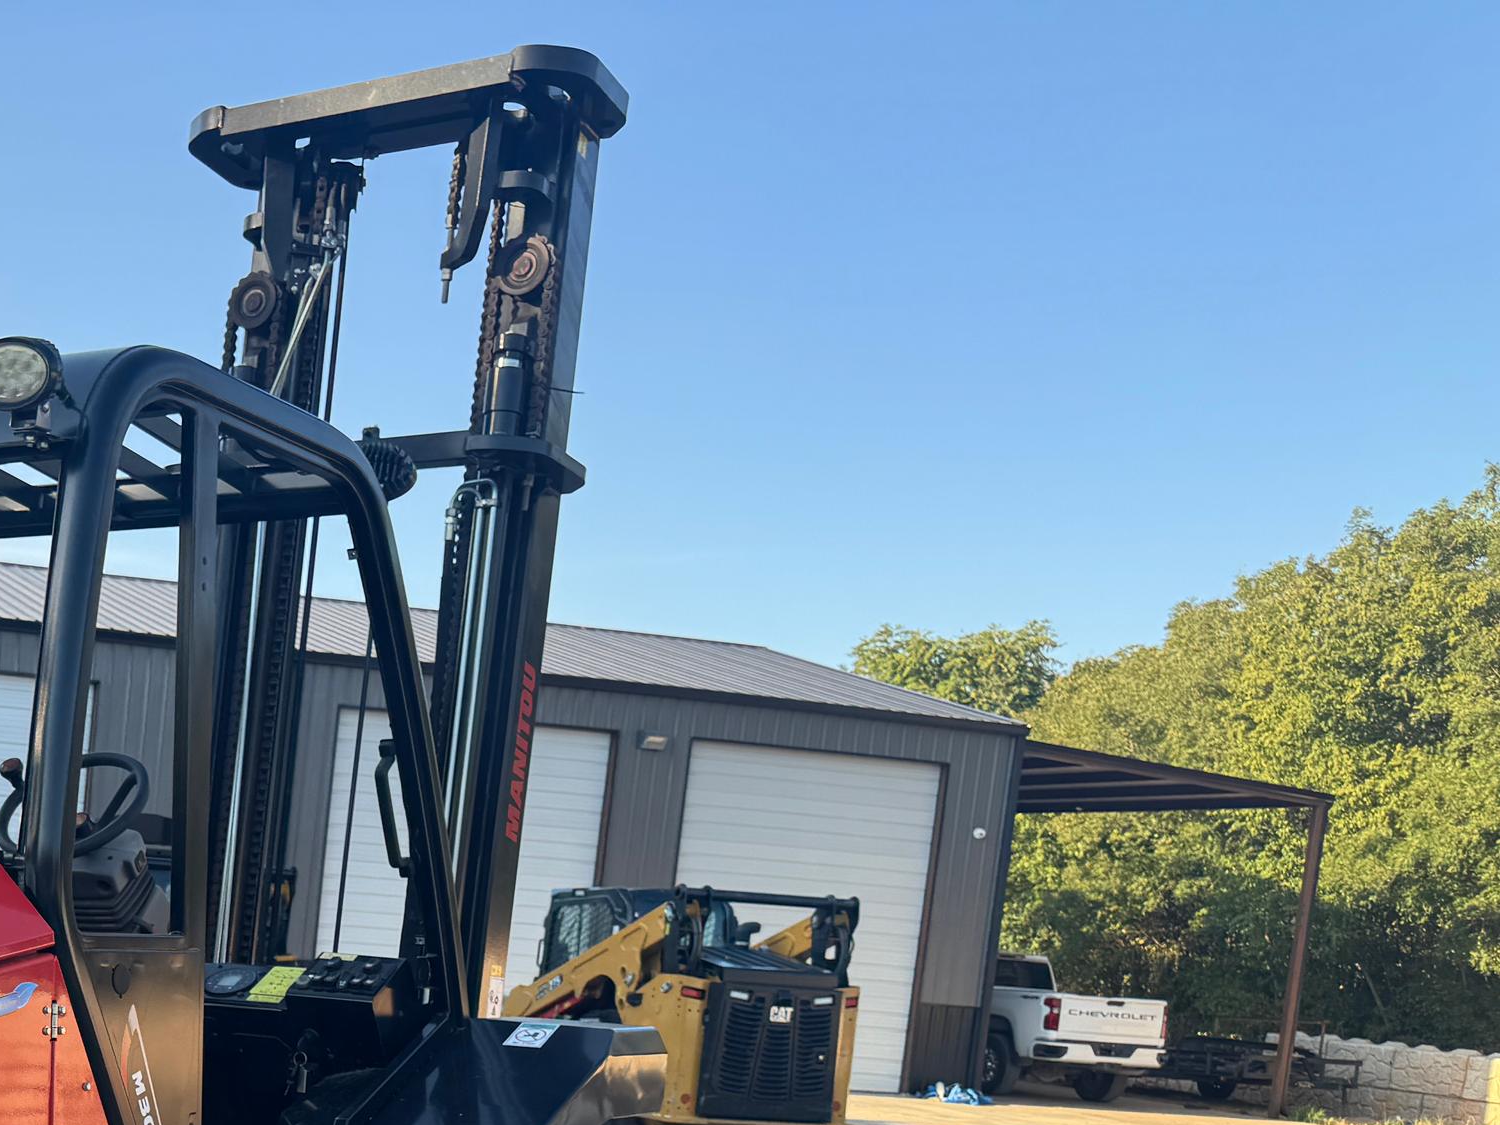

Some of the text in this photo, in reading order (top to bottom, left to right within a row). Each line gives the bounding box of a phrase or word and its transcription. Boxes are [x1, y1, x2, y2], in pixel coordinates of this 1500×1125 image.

[505, 661, 537, 843] MANITOU
[770, 1005, 794, 1023] CAT
[1068, 1008, 1157, 1021] CHEVROLET
